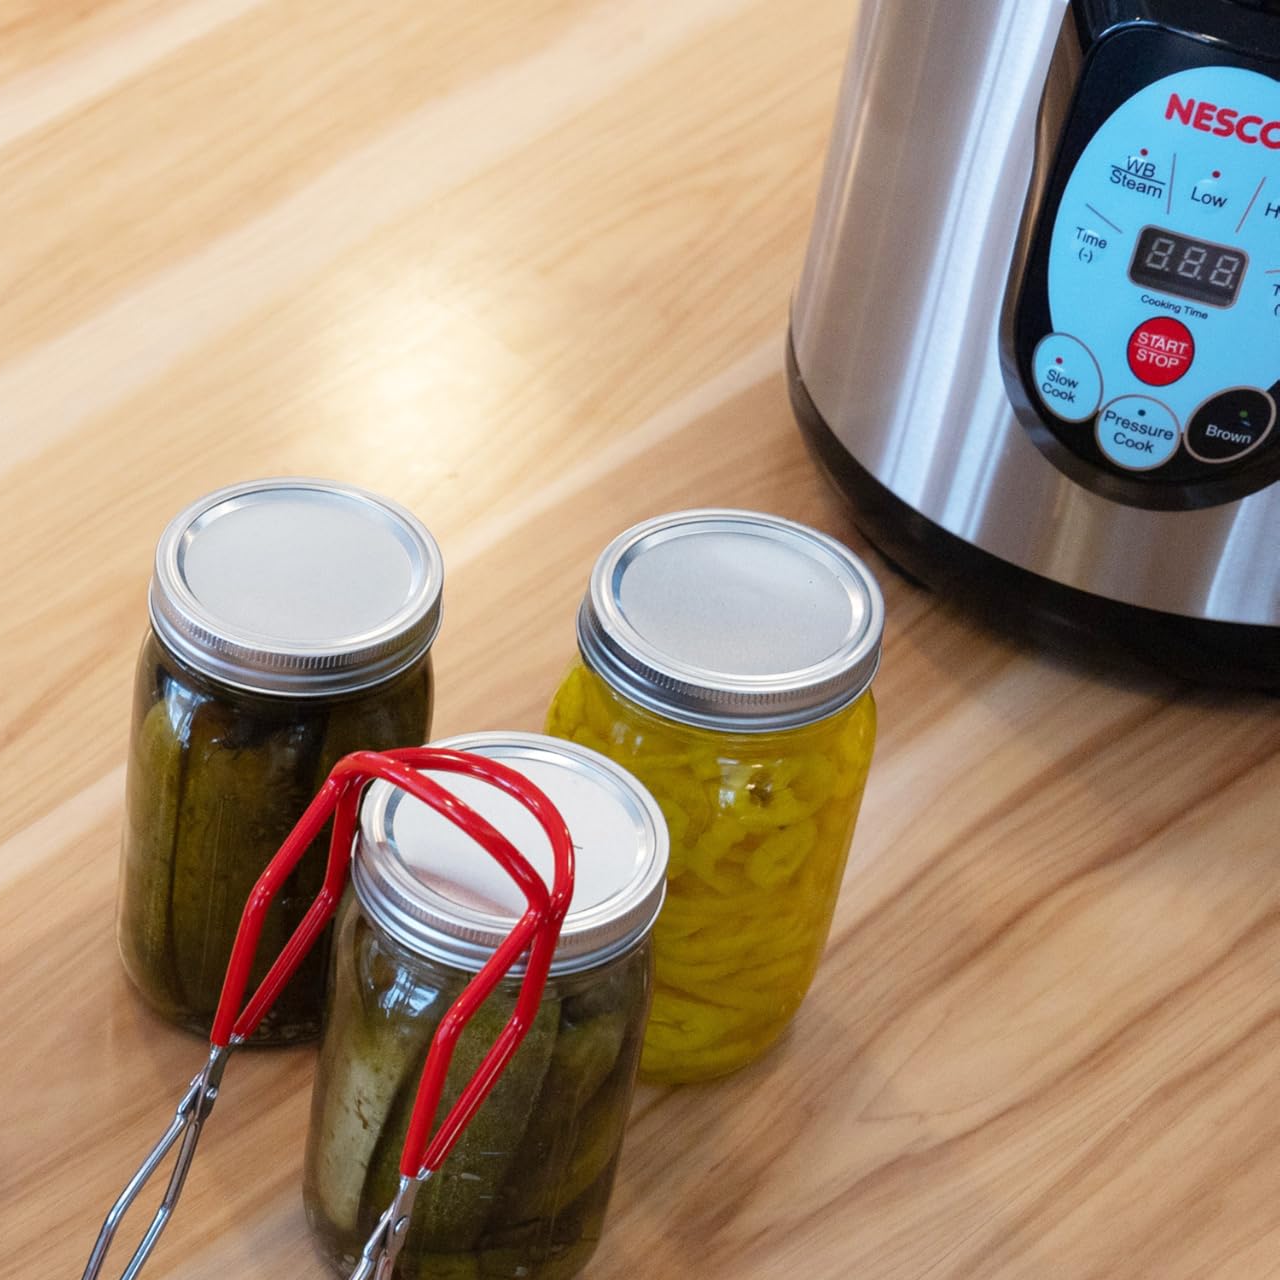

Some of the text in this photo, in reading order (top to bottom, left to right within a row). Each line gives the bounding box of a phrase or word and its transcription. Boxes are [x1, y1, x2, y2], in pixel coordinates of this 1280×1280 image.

[1165, 93, 1280, 149] NESCO
[1126, 155, 1156, 178] WB
[1109, 169, 1162, 199] Steam
[1190, 186, 1228, 208] Low
[1076, 227, 1107, 249] Time
[1140, 294, 1209, 320] Cooking Time
[1137, 331, 1189, 355] START
[1135, 347, 1180, 369] STOP
[1046, 369, 1079, 389] Slow
[1041, 382, 1076, 404] Cook
[1103, 409, 1174, 441] Pressure
[1205, 423, 1252, 445] Brown
[1112, 431, 1155, 454] Cook
